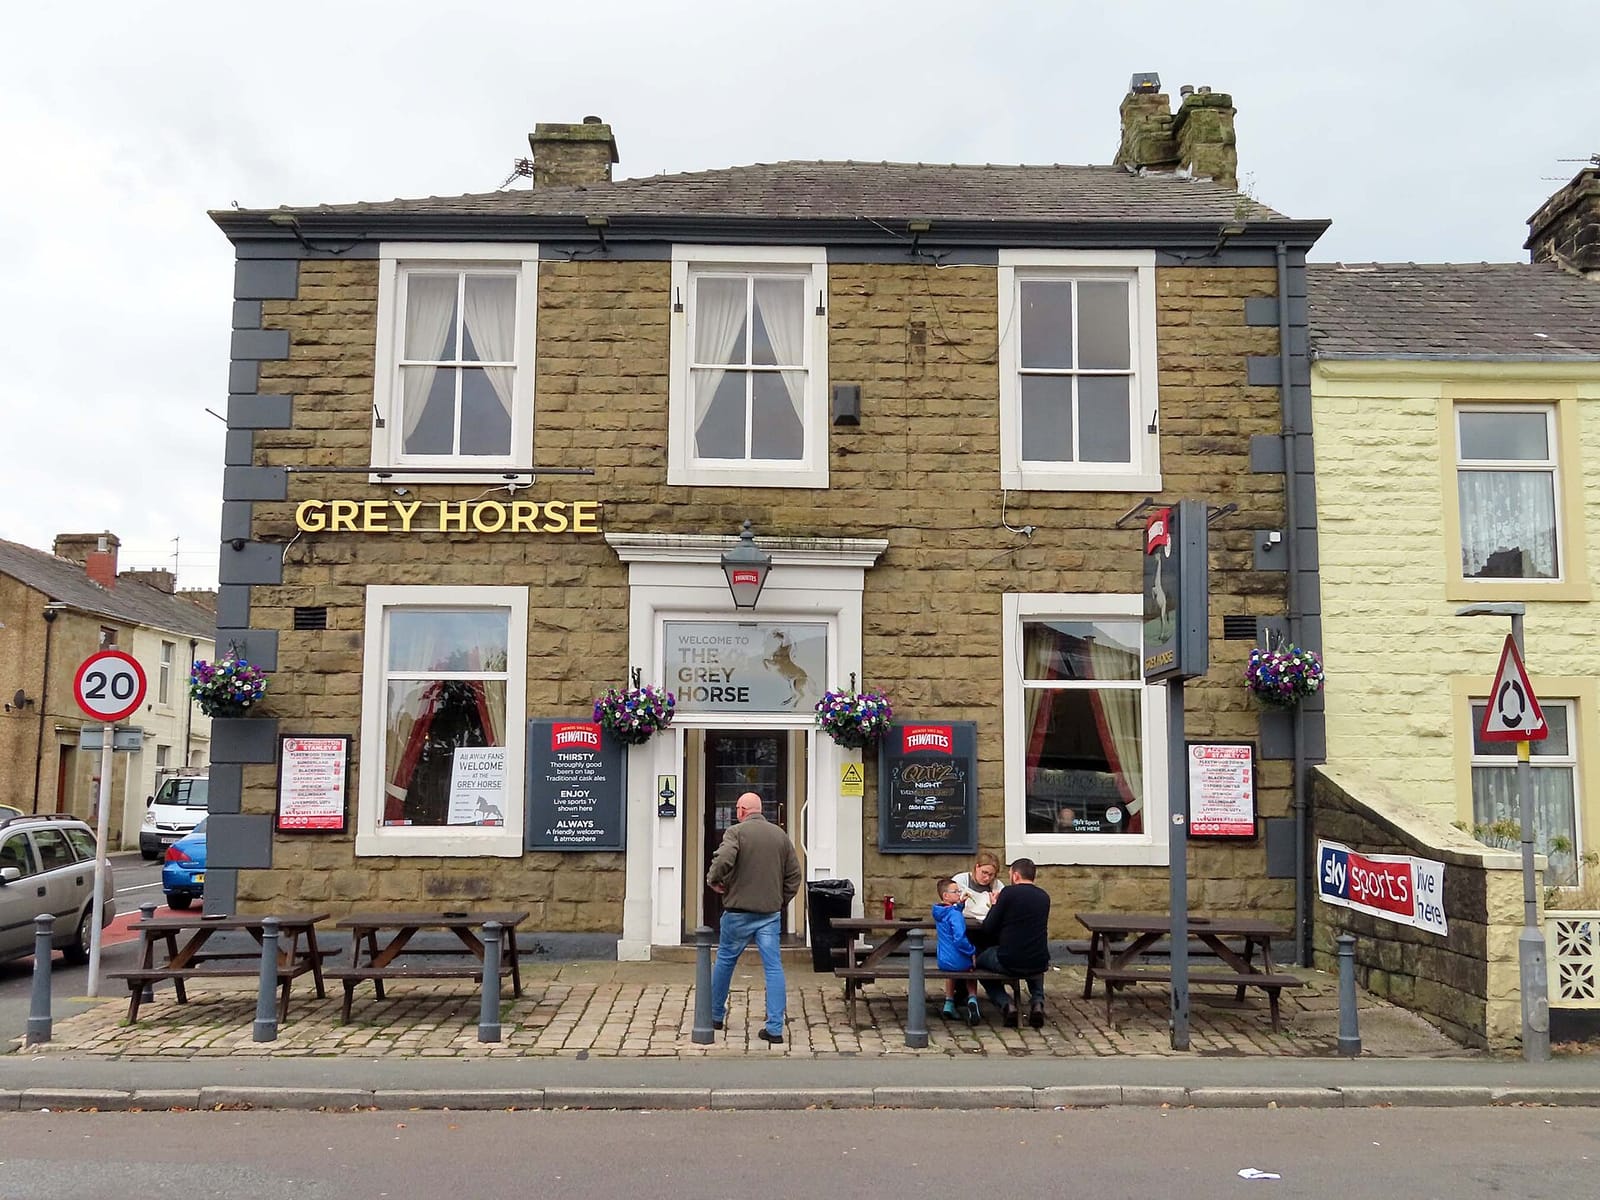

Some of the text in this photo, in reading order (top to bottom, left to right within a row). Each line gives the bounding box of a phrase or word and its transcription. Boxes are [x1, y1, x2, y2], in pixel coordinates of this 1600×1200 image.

[295, 499, 599, 533] GREY HORSE
[679, 636, 749, 645] WELCOME TO
[679, 648, 719, 664] THE
[678, 667, 735, 683] GREY
[85, 671, 135, 700] 20
[678, 686, 750, 702] HORSE
[555, 730, 598, 745] THWAITES
[907, 733, 949, 748] THWAITES
[558, 753, 594, 761] THIRSTY
[460, 762, 504, 771] WELCOME
[550, 761, 585, 769] Thoroughly
[457, 780, 502, 788] GREY HORSE
[560, 790, 590, 798] ENJOY
[556, 820, 594, 828] ALWAYS
[552, 828, 576, 836] friendly
[1324, 853, 1408, 902] sky sports
[1416, 865, 1434, 893] live
[1416, 895, 1442, 925] here
